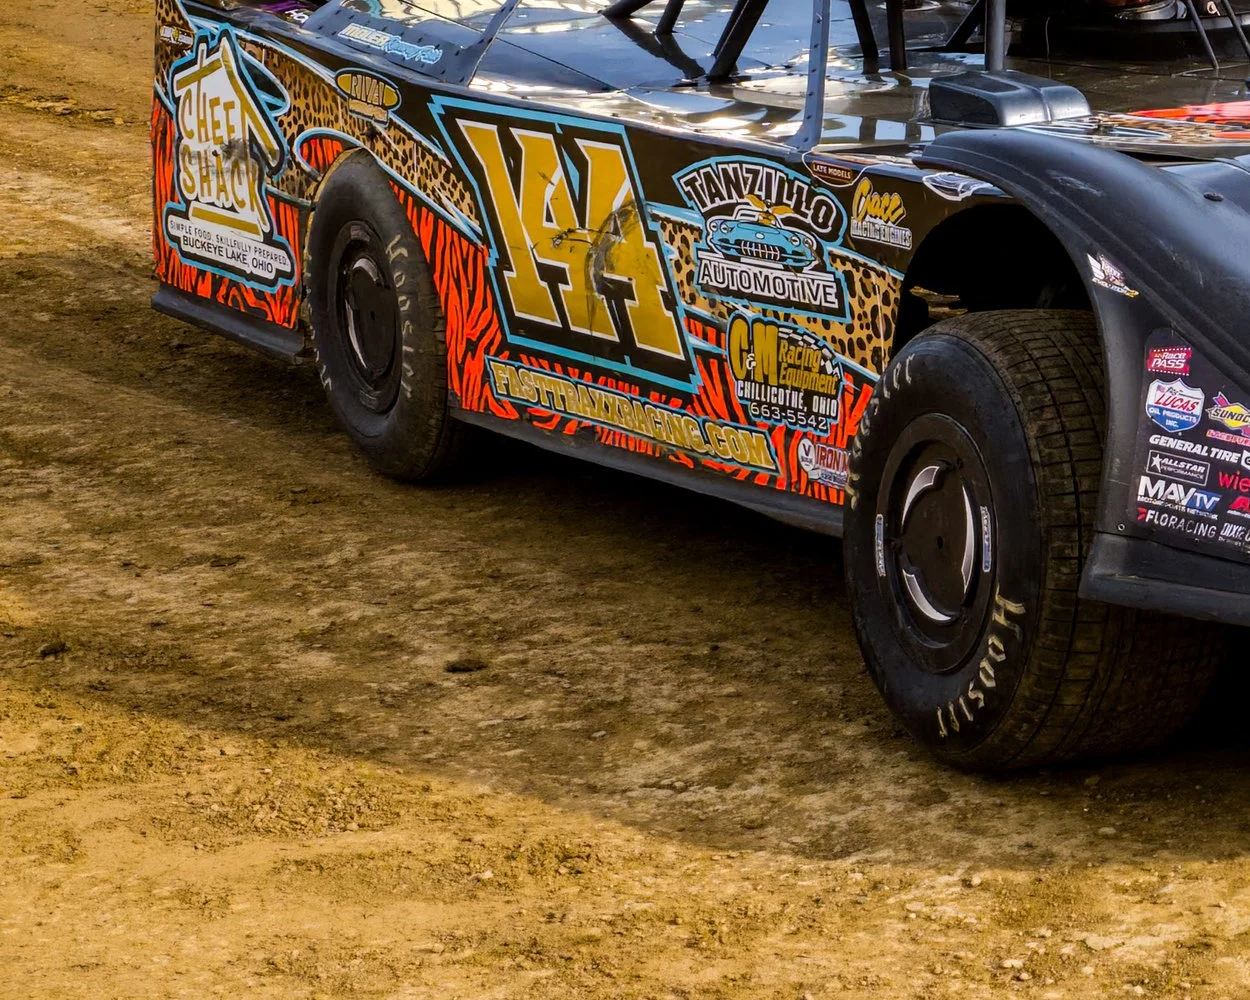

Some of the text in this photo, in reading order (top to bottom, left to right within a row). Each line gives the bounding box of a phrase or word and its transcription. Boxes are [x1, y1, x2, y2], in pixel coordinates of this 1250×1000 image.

[351, 74, 388, 107] RIVAL
[182, 144, 265, 222] SHACK
[812, 164, 852, 180] LATE MODELS
[680, 163, 836, 233] TANZILLO
[170, 220, 192, 236] SIMPLE
[216, 234, 251, 254] SKILLFULLY
[852, 220, 879, 239] RACING
[182, 235, 273, 274] BUCKEYE LAKE, OHIO
[699, 259, 838, 309] AUTOMOTIVE
[780, 339, 821, 373] Racing
[1152, 359, 1186, 369] PASS
[780, 362, 839, 395] Equipment
[737, 380, 838, 417] CHILLICOTHE, OHIO
[1149, 407, 1197, 423] OIL PRODUCTS
[1154, 393, 1199, 412] LUCAS
[490, 361, 776, 470] FASTTRAXXRACING.COM
[750, 402, 827, 430] 663-5542
[1149, 435, 1208, 457] GENERAL
[1210, 447, 1241, 463] TIRE
[1161, 458, 1206, 473] ALLSTAR
[1145, 509, 1217, 538] FLORACING
